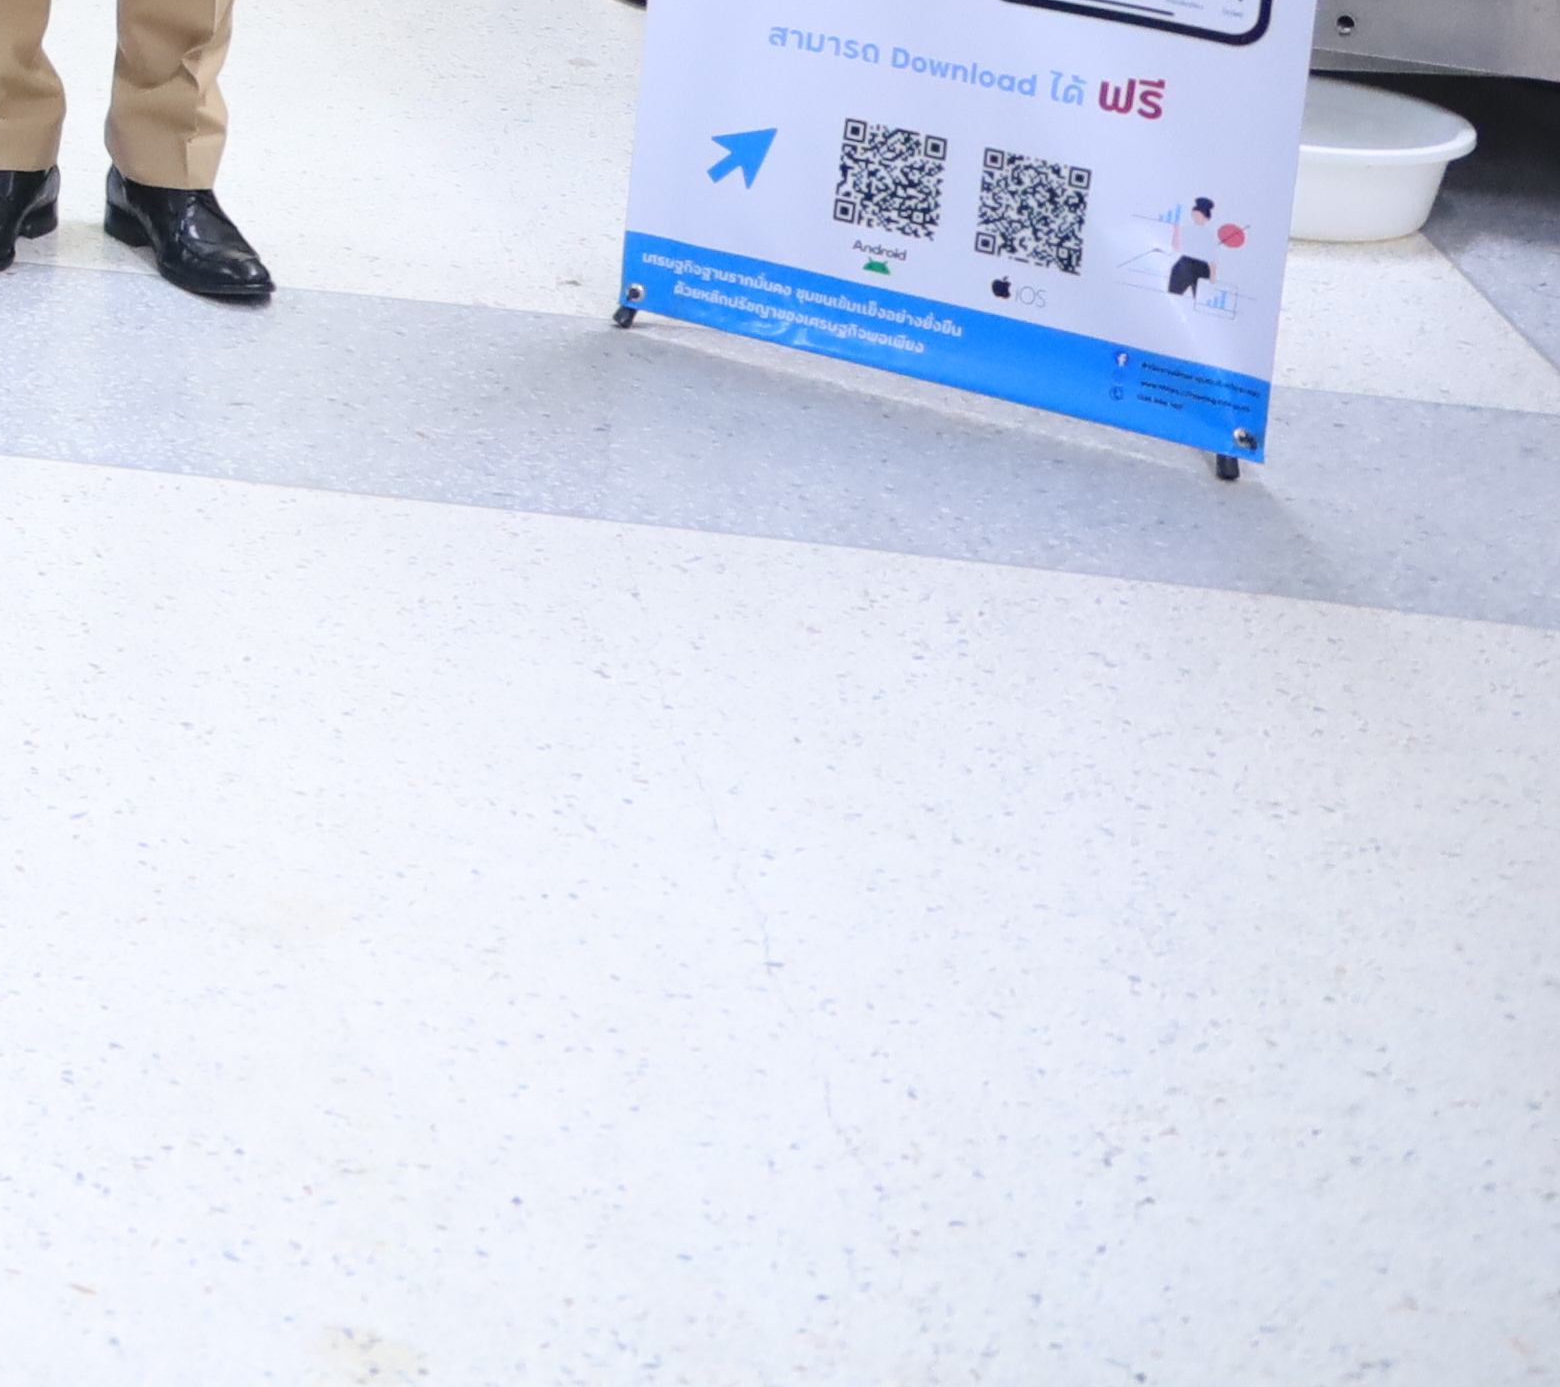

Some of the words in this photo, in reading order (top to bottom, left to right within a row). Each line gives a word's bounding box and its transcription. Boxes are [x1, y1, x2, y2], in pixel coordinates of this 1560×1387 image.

[768, 23, 880, 66] สามารถ
[891, 46, 1038, 98] Download
[1049, 69, 1085, 108] ได้
[1098, 75, 1166, 121] ฟรี
[852, 238, 908, 263] Android
